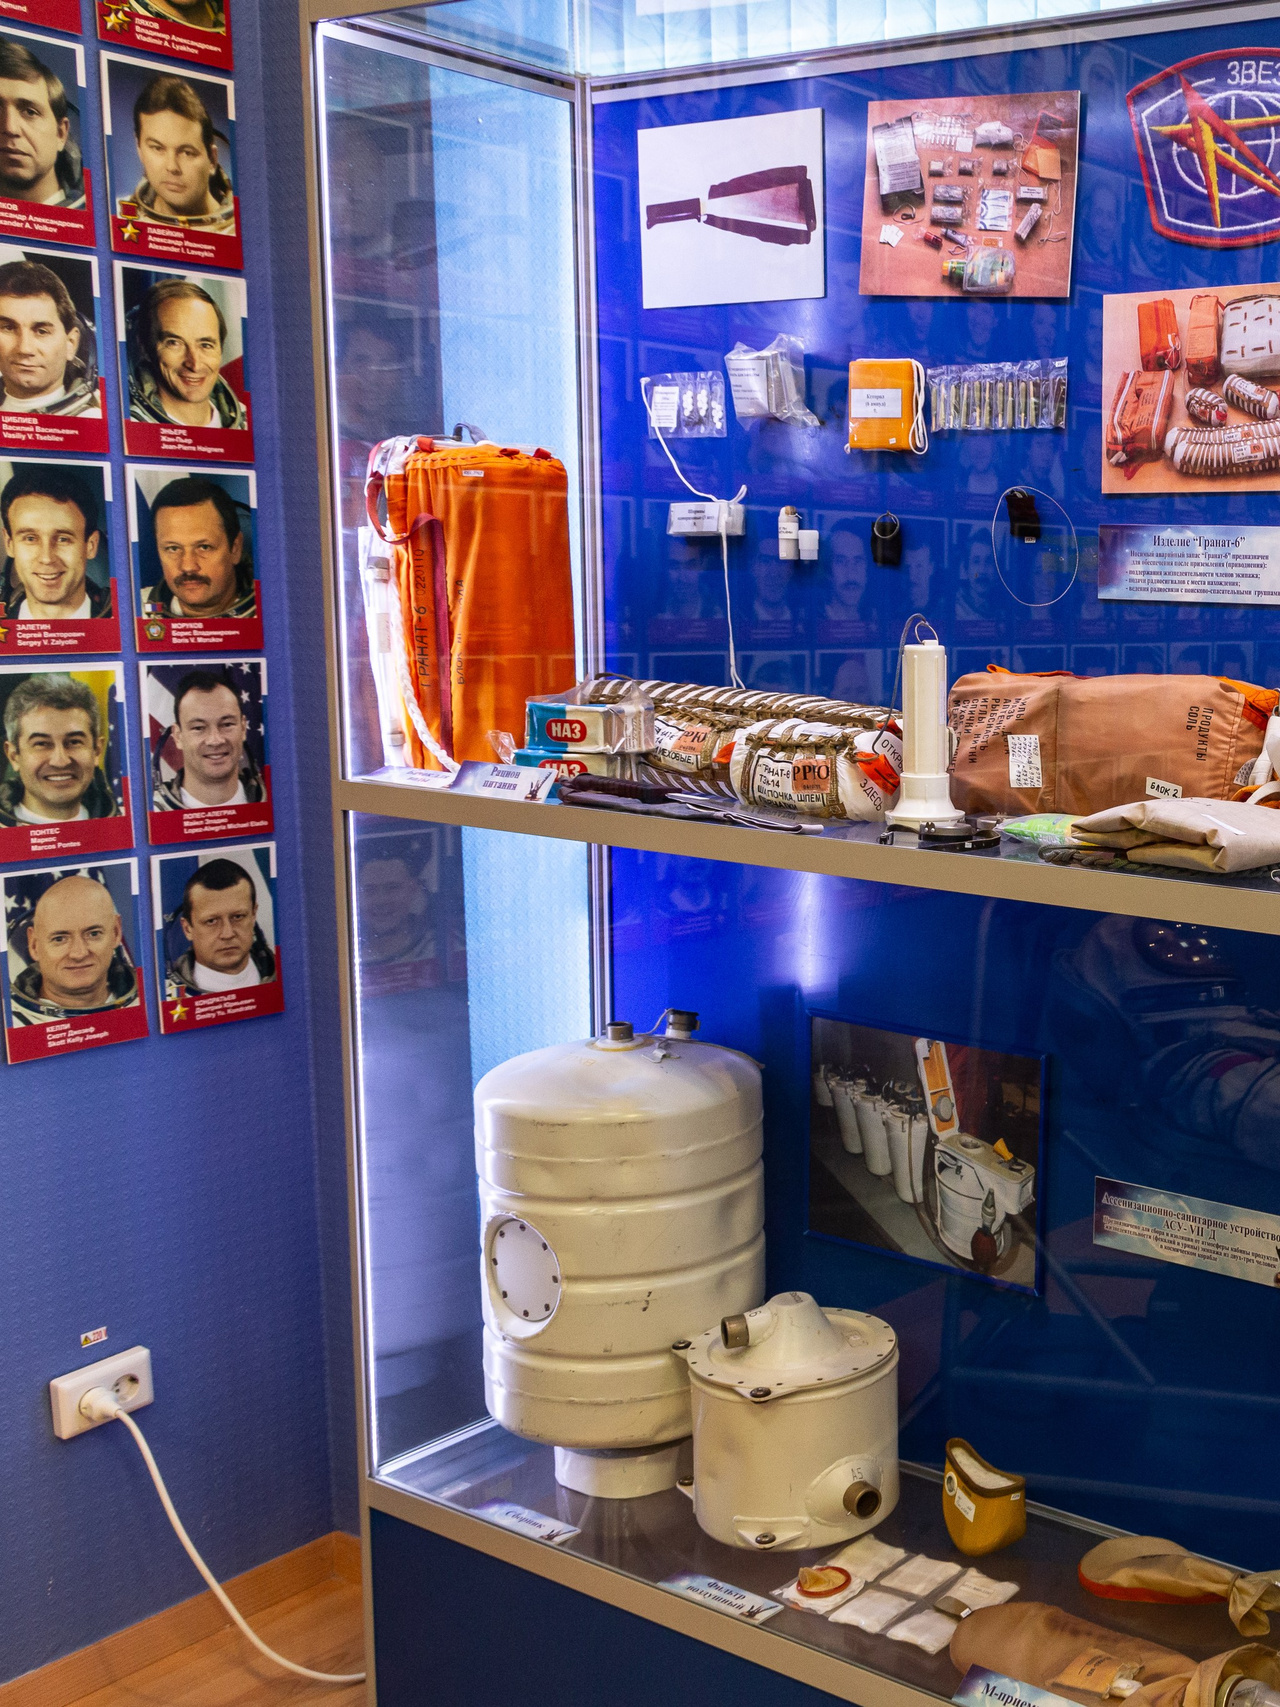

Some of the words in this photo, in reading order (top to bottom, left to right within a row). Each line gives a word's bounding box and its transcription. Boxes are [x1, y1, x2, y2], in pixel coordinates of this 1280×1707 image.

[1153, 535, 1191, 547] Изделие
[17, 639, 42, 647] Sergey
[964, 698, 979, 734] СПИЧКИ
[992, 698, 1012, 737] АПТЕЧКА
[1006, 698, 1021, 720] МАЗЬ
[1186, 705, 1200, 731] СОЛЬ
[551, 722, 581, 739] НАЗ
[979, 698, 1000, 751] РЫБСНАСТЬ
[1196, 707, 1214, 761] ПРОДУКТЫ
[968, 733, 981, 763] НИТКИ
[490, 766, 521, 779] Рацион
[482, 780, 518, 791] питания
[860, 778, 883, 812] ЗДЕСЬ
[1149, 781, 1170, 796] БЛОК
[30, 828, 61, 837] ПОНТЕС
[1101, 1191, 1228, 1230] Ассенизационно-санитарное
[1208, 1229, 1217, 1242] Д
[505, 1510, 546, 1530] Сборник
[686, 1584, 745, 1611] воздушный
[707, 1580, 746, 1602] Фильтр
